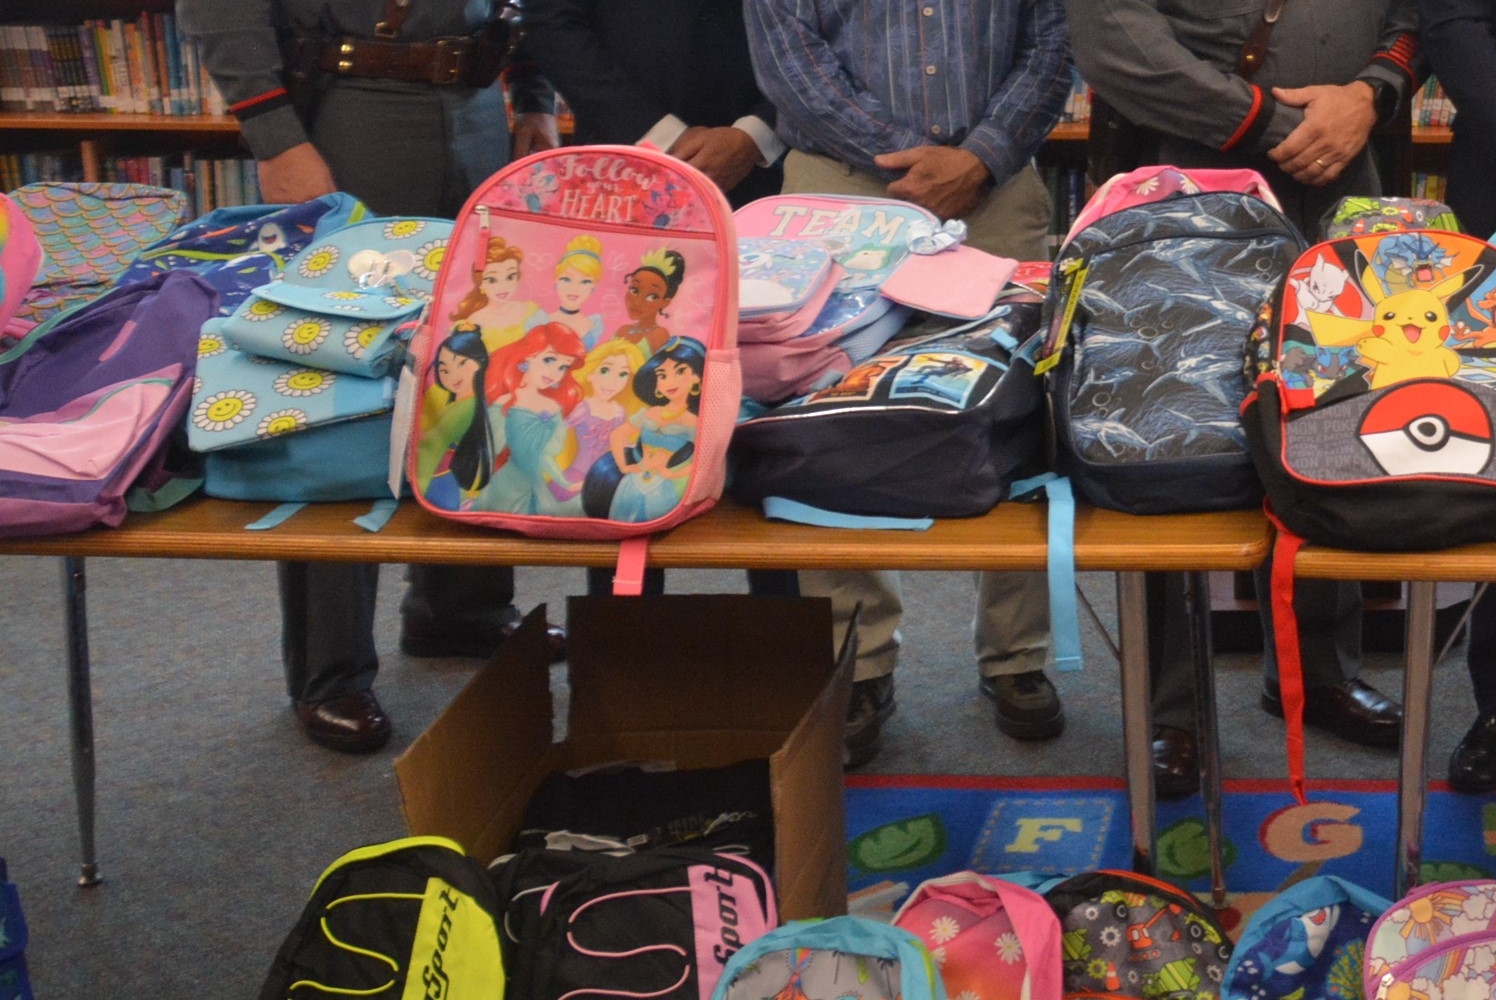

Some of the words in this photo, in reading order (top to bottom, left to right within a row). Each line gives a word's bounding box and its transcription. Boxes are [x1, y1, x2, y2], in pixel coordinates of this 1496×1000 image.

[560, 153, 662, 191] Follow
[586, 180, 623, 195] your
[560, 188, 638, 224] HEART
[768, 204, 906, 245] TEAM
[1003, 817, 1083, 854] F
[1259, 801, 1363, 862] G
[704, 868, 744, 965] Sport
